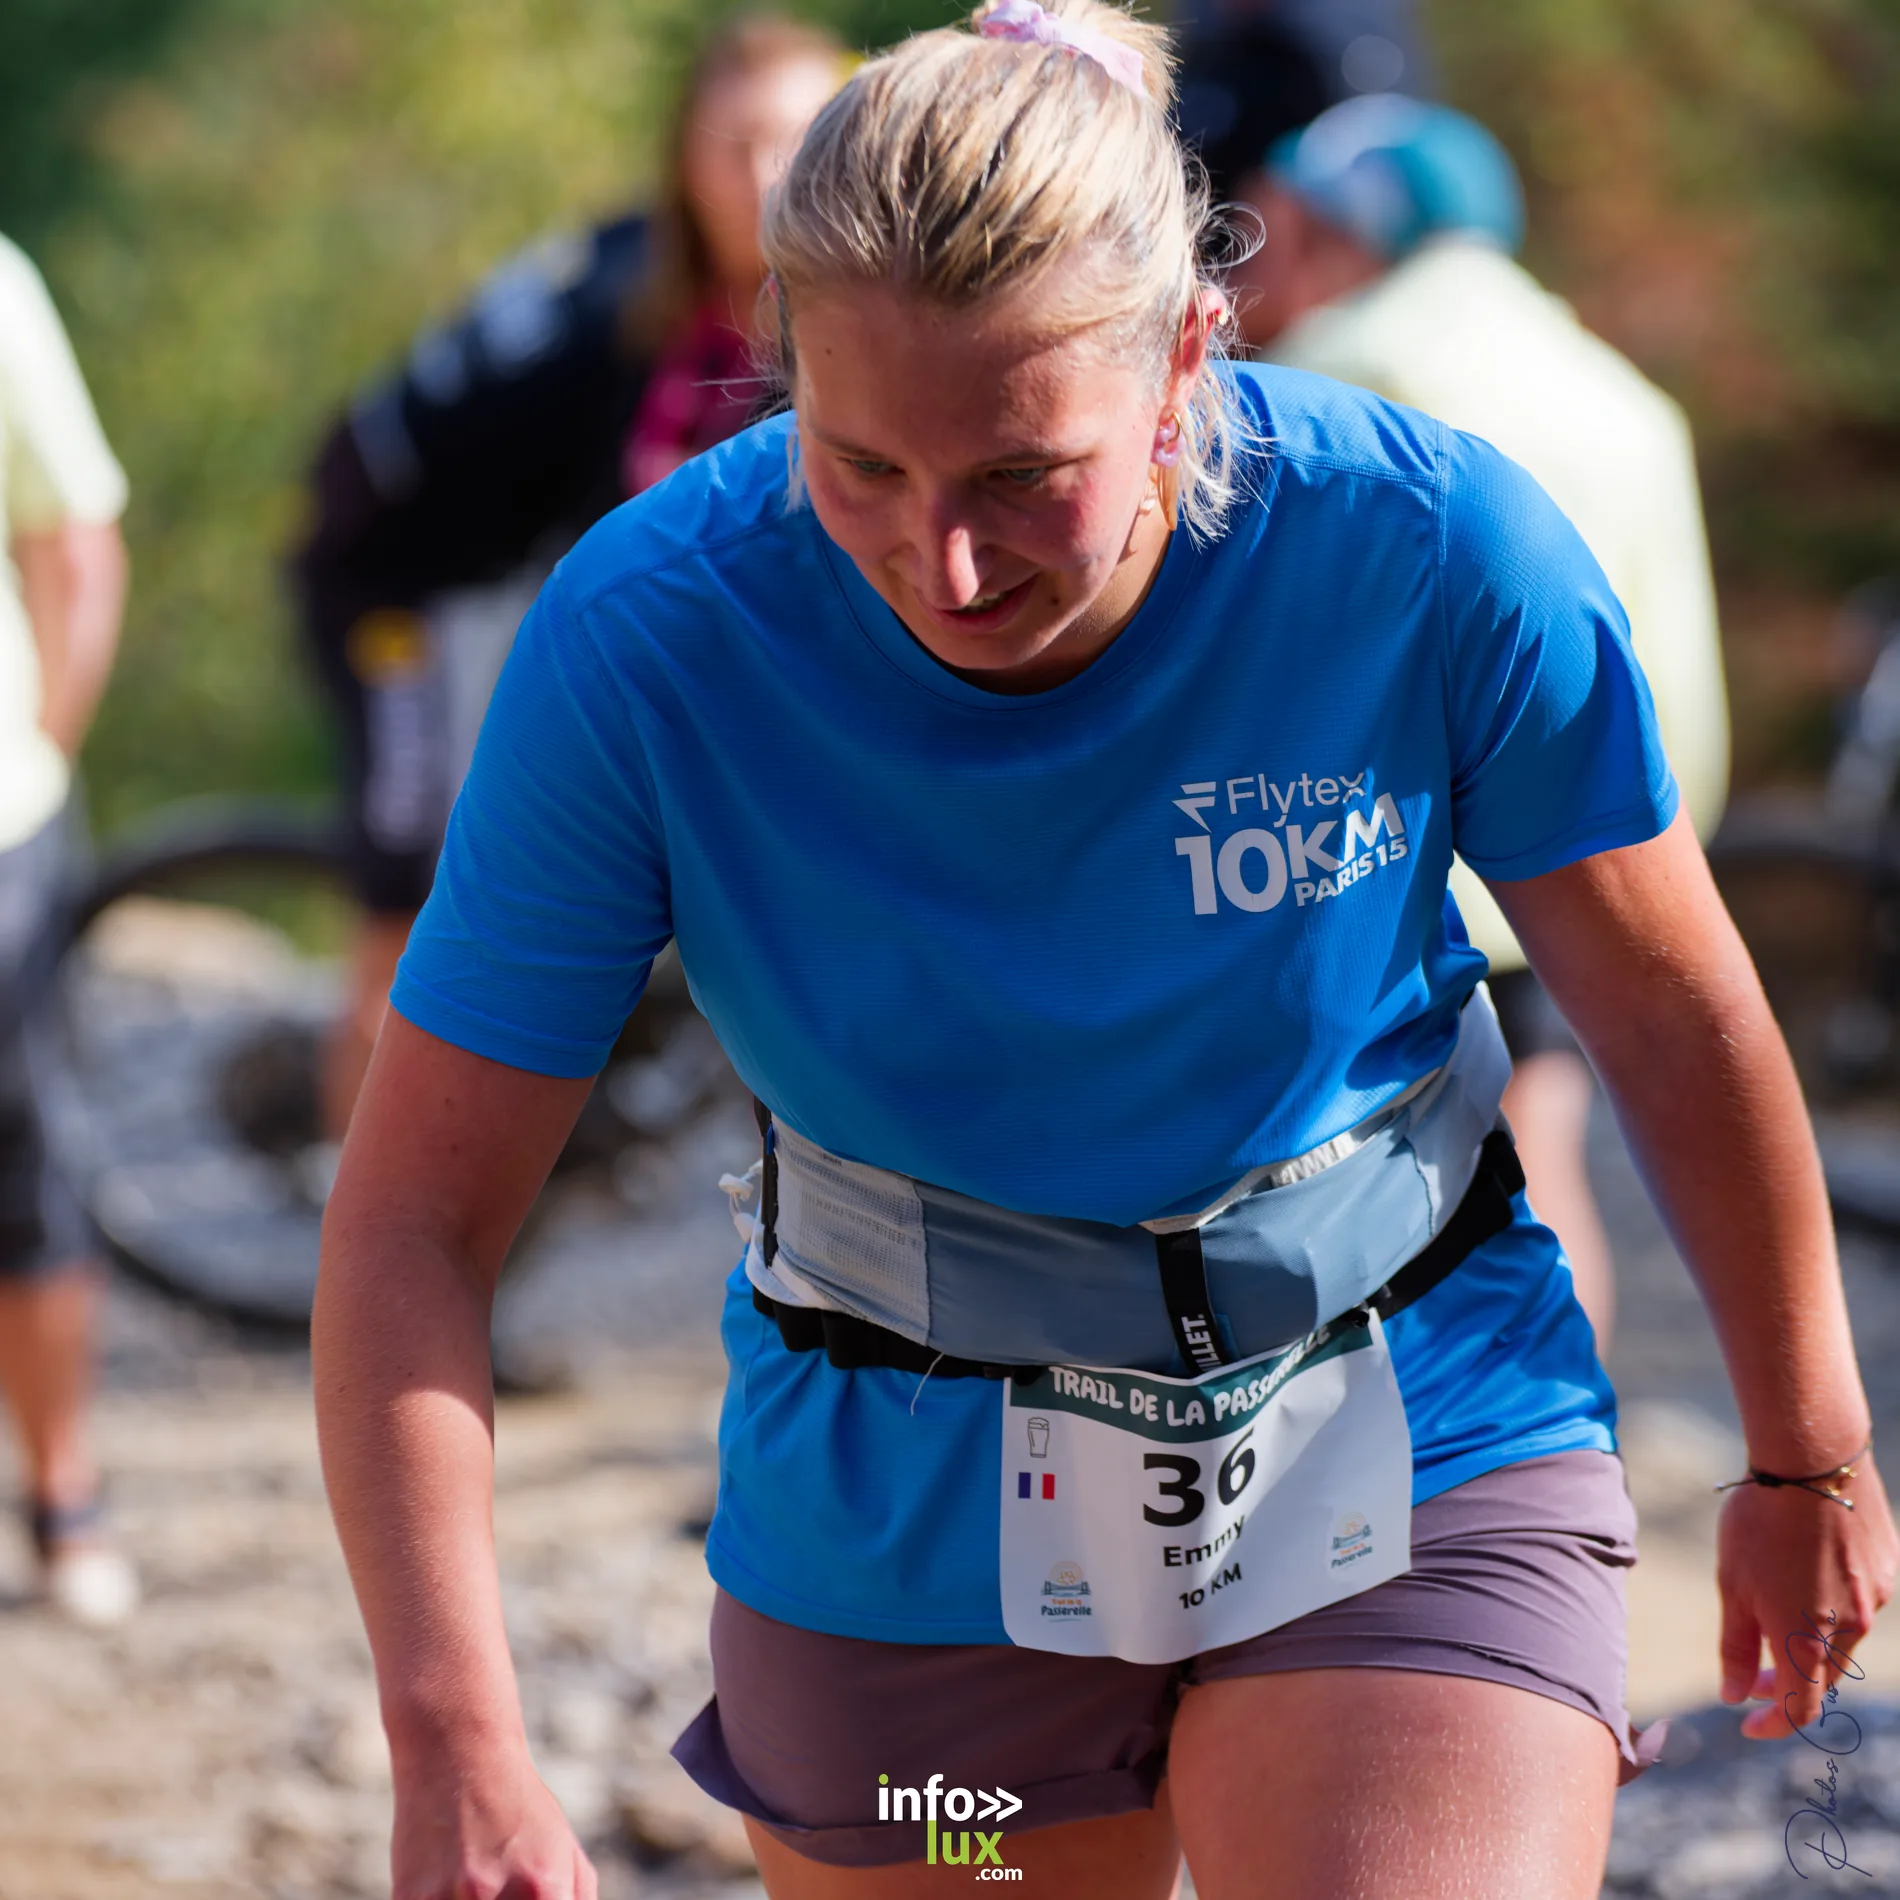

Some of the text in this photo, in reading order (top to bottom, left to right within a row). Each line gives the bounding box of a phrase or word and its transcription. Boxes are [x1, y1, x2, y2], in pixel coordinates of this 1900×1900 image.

[1226, 772, 1366, 828] Flytex
[1294, 837, 1408, 907] PARIS 15
[1049, 1366, 1124, 1409] TRAIL
[1130, 1388, 1159, 1422] DE
[1166, 1400, 1206, 1427] LA
[1143, 1424, 1256, 1528] 36
[1163, 1514, 1245, 1568] Emmy
[1179, 1562, 1242, 1610] 10 KM
